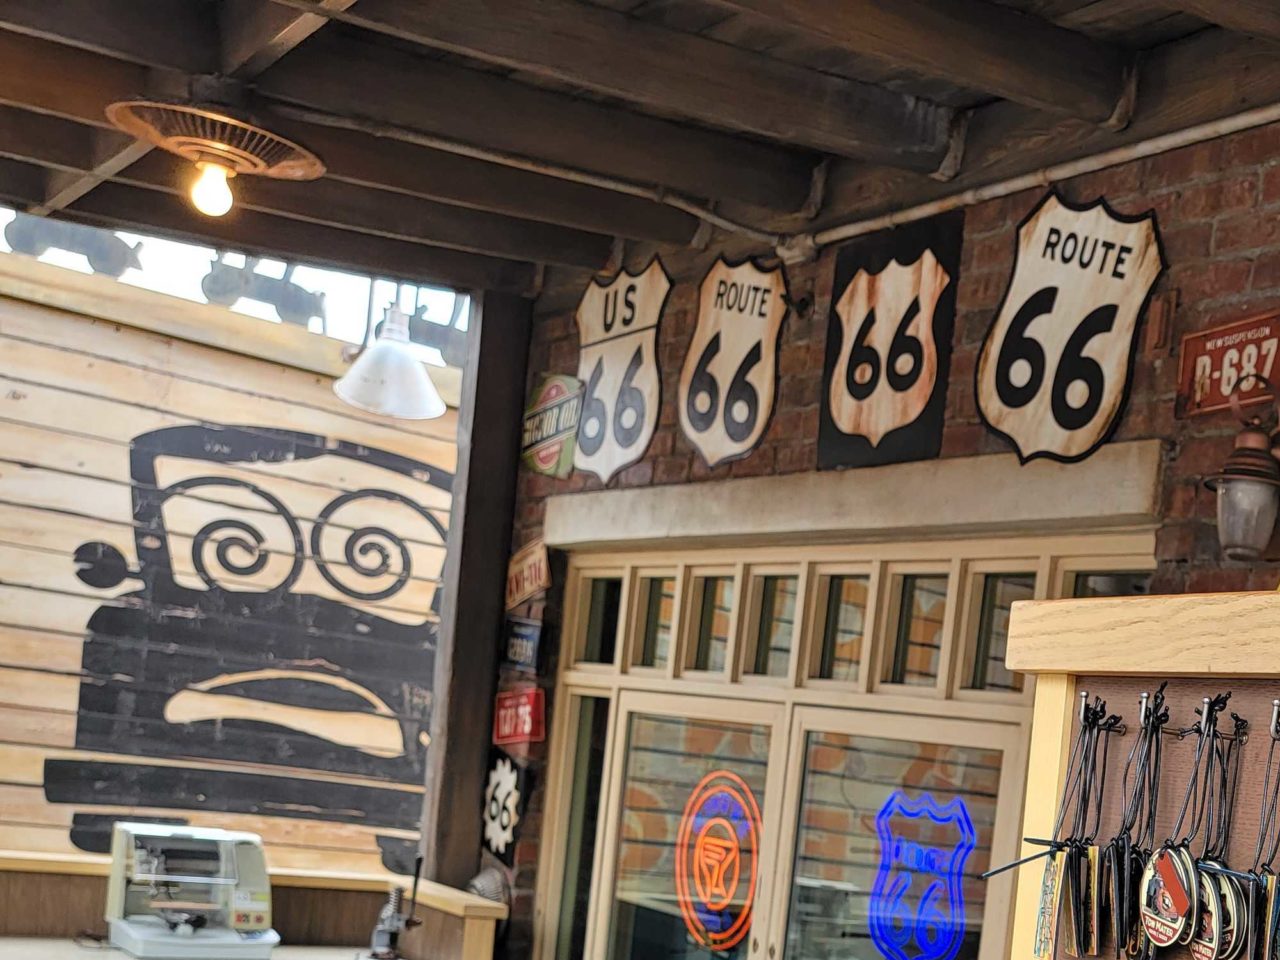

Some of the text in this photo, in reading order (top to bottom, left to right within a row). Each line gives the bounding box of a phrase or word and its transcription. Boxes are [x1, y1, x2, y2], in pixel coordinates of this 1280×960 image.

[1041, 227, 1133, 279] ROUTE
[603, 285, 637, 333] US
[714, 280, 772, 318] ROUTE
[686, 331, 762, 442] 66
[846, 295, 924, 400] 66
[995, 286, 1119, 431] 66
[576, 344, 647, 457] 66
[490, 782, 512, 831] 66
[882, 870, 954, 957] 66
